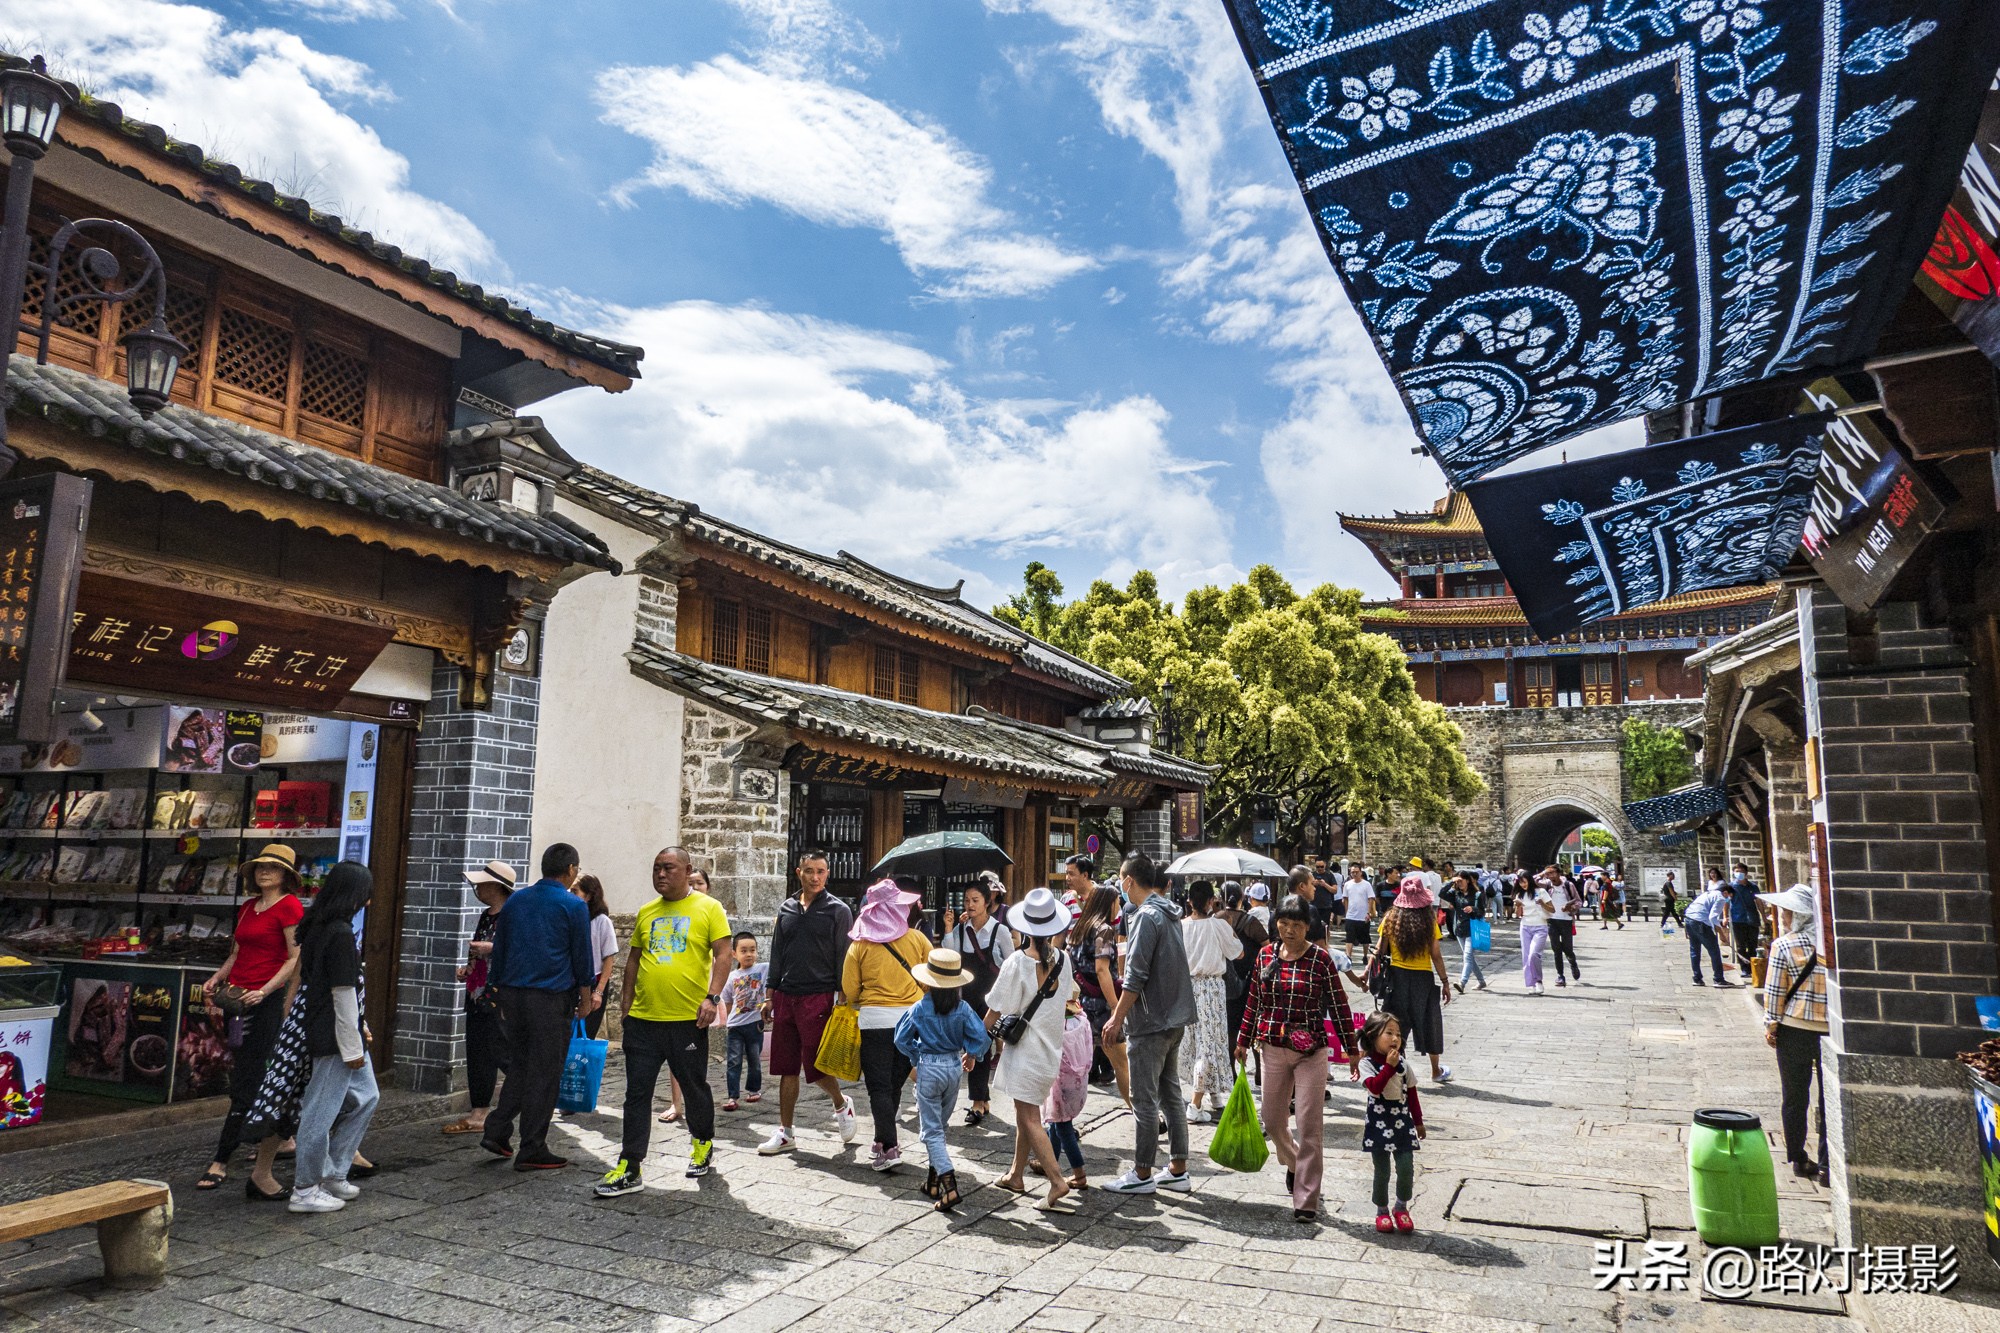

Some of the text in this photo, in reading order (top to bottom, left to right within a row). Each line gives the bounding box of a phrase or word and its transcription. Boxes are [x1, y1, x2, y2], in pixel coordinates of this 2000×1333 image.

[1854, 518, 1894, 575] YAK MEAT
[7, 529, 38, 662] 只有文明的市民
[73, 647, 114, 662] Xiang
[234, 671, 262, 681] Xian
[272, 676, 294, 686] Hua
[303, 680, 328, 692] Bing
[243, 643, 348, 679] 鲜花饼
